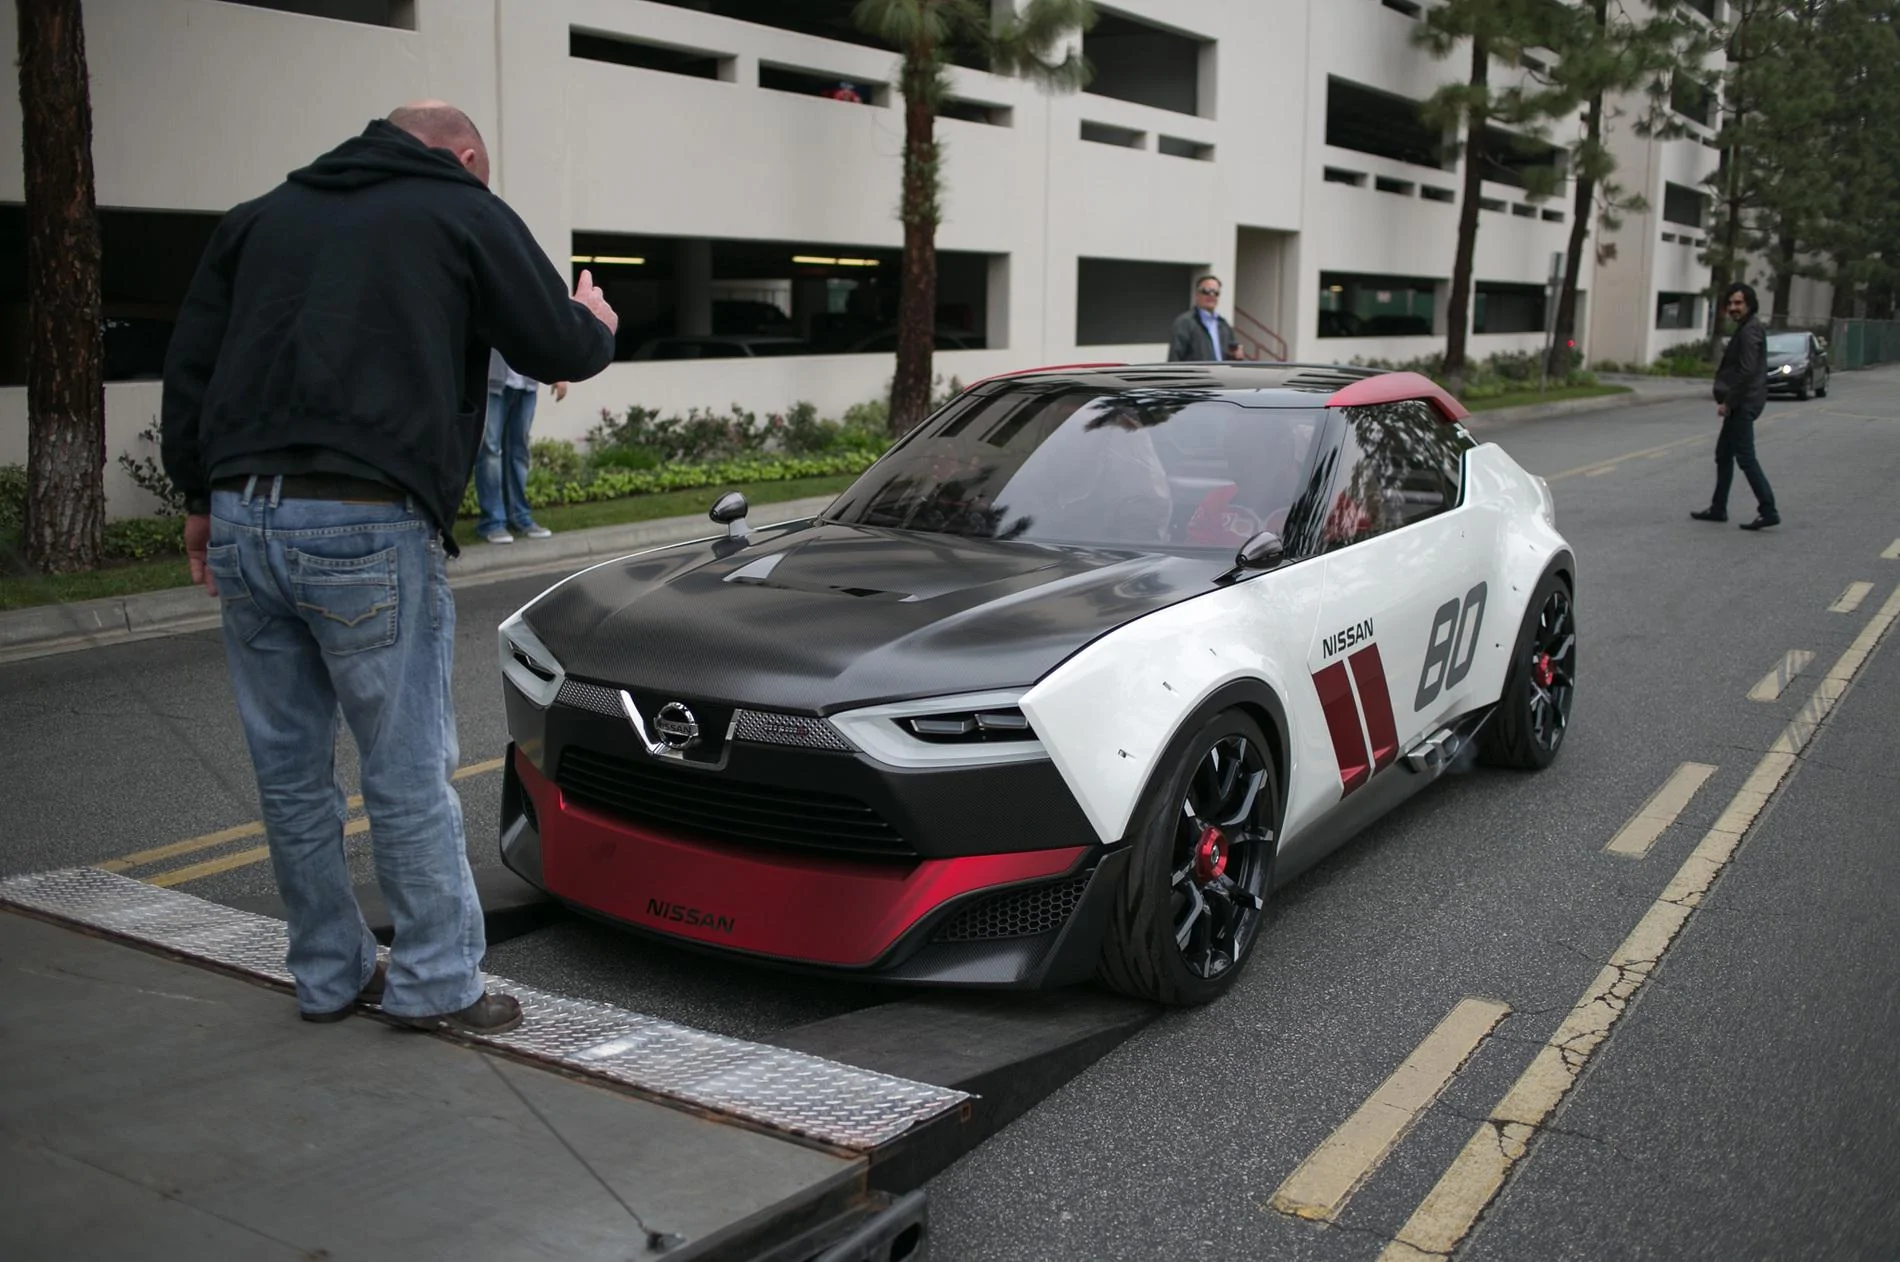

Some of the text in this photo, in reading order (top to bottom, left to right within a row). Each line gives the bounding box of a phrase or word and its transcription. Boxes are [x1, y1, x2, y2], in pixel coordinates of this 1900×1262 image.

[1322, 616, 1374, 660] NISSAN
[1414, 580, 1488, 713] 80
[645, 897, 735, 934] NISSAN
